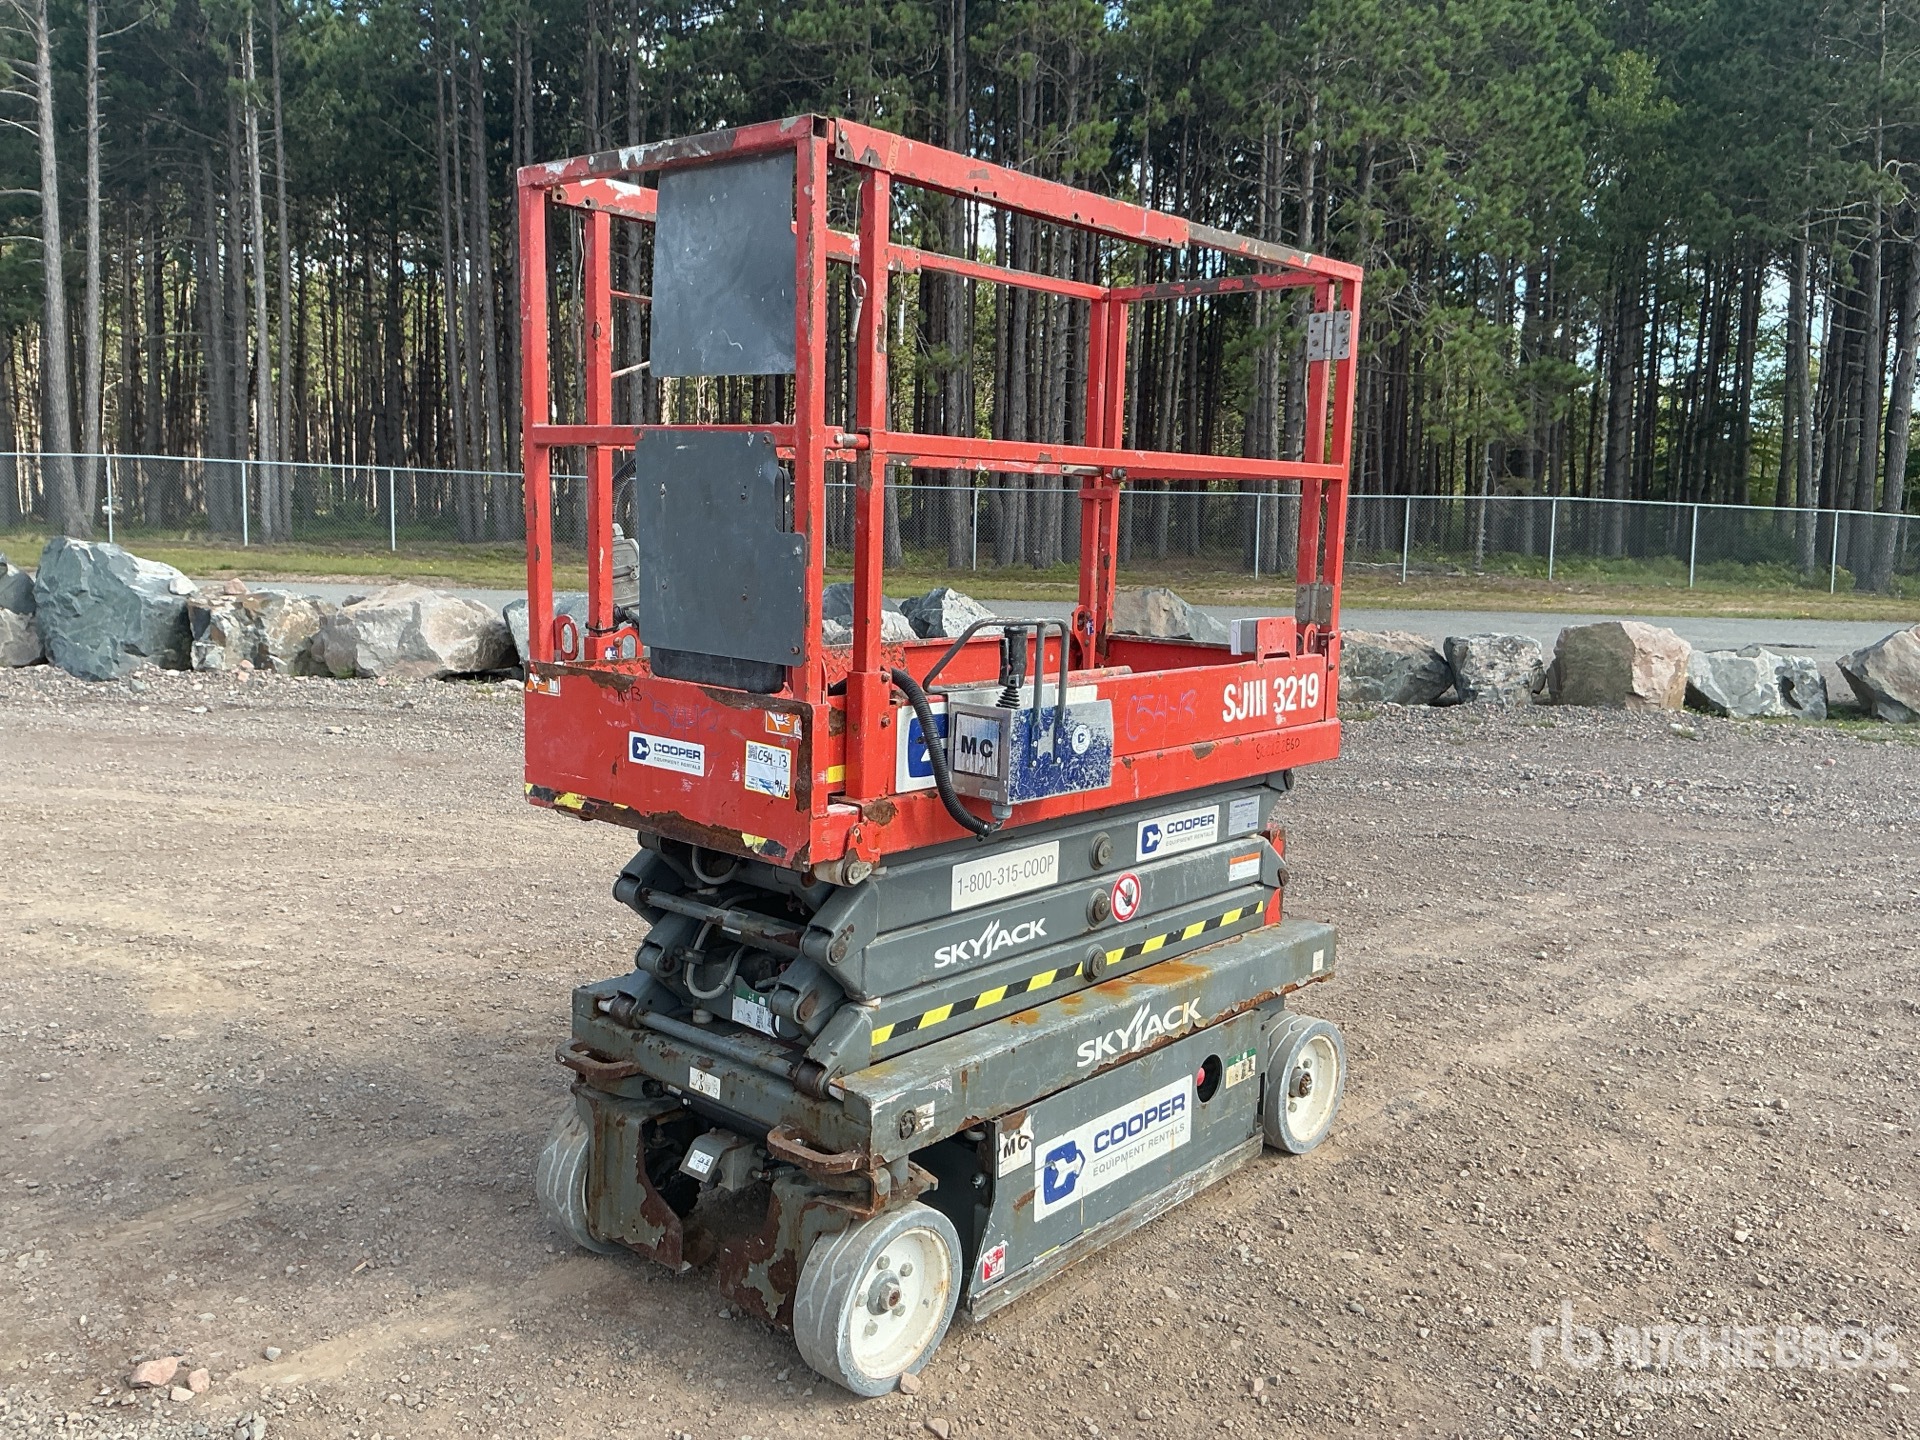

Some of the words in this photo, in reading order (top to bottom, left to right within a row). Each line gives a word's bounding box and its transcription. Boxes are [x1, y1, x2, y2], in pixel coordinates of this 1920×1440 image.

[1273, 672, 1319, 713] 3219
[653, 742, 701, 761] COOPER
[961, 735, 993, 757] MC
[653, 757, 680, 767] EQUIPMENT
[680, 762, 701, 771] RENTALS
[1165, 835, 1193, 847] EQUIPMENT
[1193, 831, 1215, 840] RENTALS
[1166, 813, 1215, 835] COOPER
[957, 854, 1055, 896] 1-800-315-COOP
[934, 917, 1048, 968] SKYJACK
[1076, 996, 1202, 1068] SKYJACK
[1093, 1092, 1186, 1154] COOPER
[1003, 1135, 1030, 1158] MC
[1092, 1143, 1146, 1177] EQUIPMENT
[1148, 1123, 1185, 1148] RENTALS
